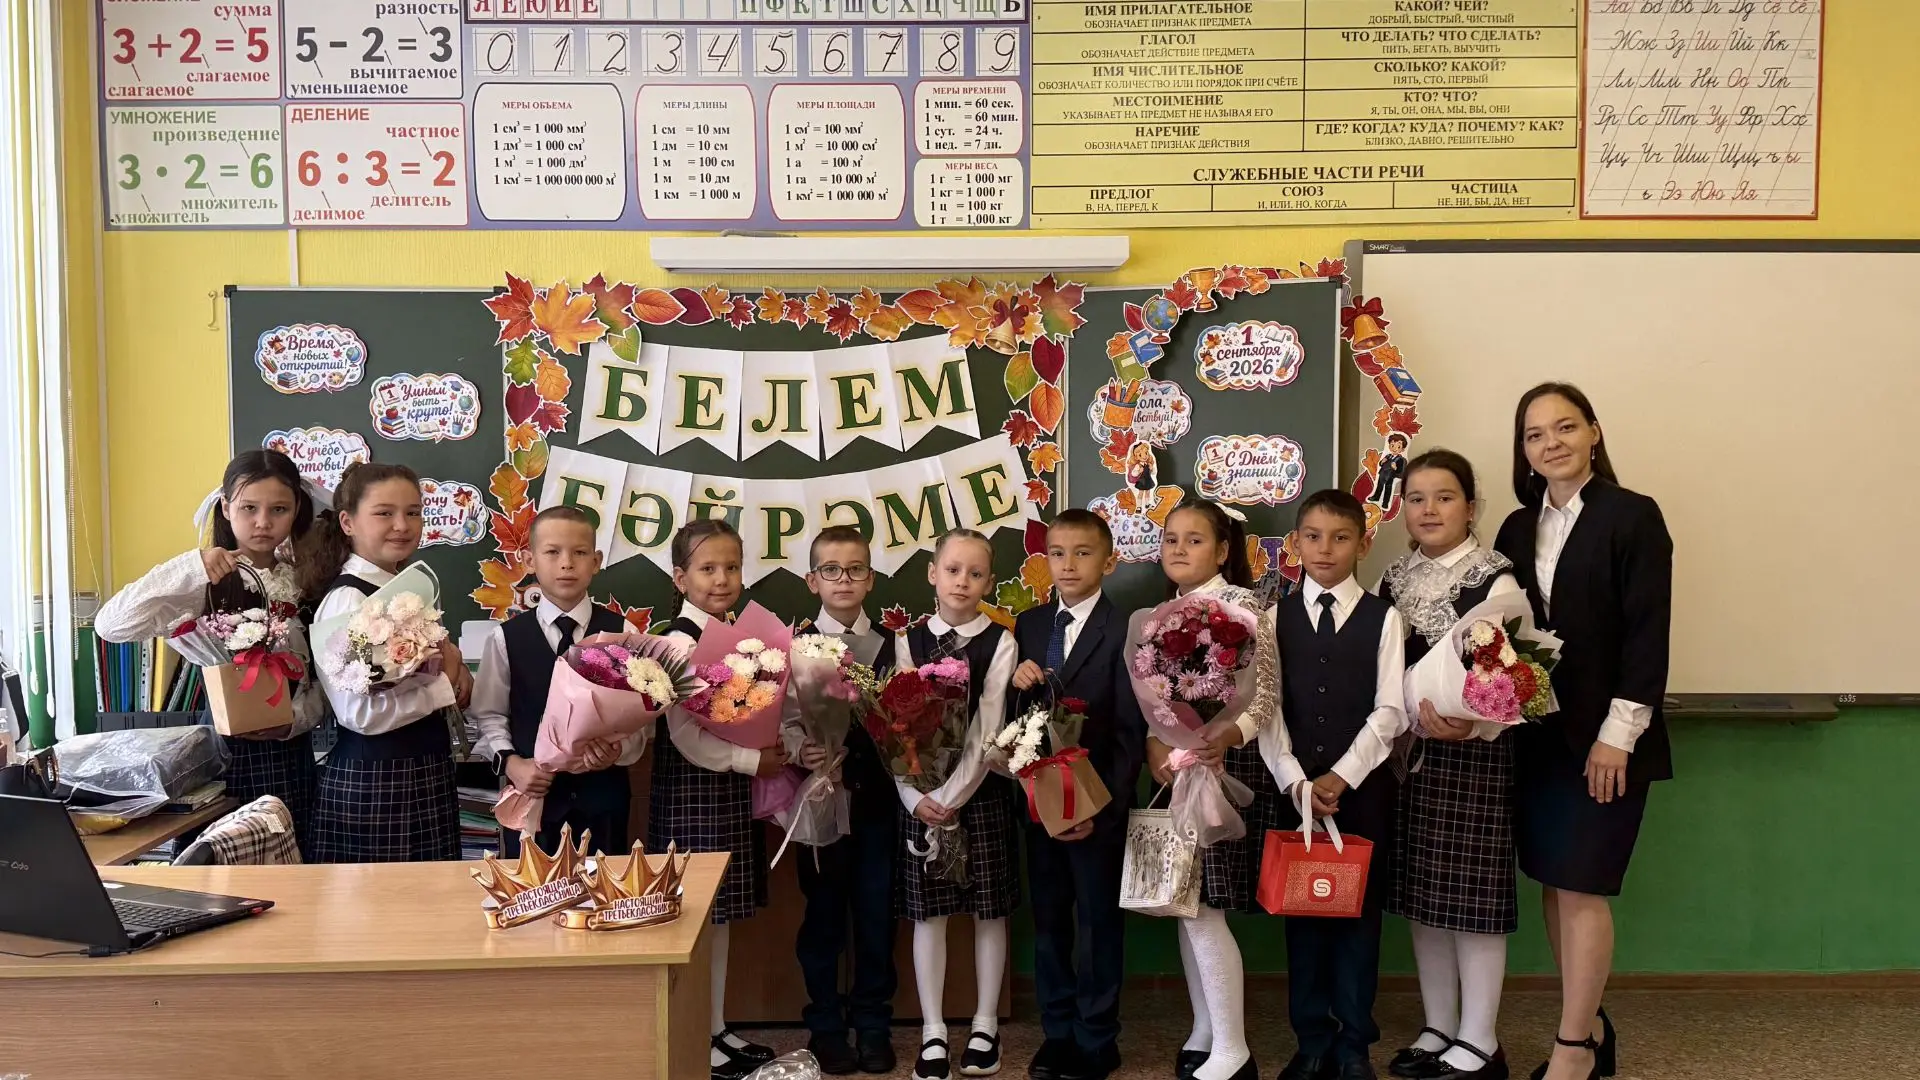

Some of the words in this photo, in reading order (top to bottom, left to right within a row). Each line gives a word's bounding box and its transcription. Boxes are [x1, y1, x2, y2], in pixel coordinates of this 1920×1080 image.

[213, 4, 272, 19] сумма
[375, 3, 459, 17] разность
[1085, 5, 1116, 16] ИМЯ
[1120, 2, 1253, 15] ПРИЛАГАТЕЛЬНОЕ
[1395, 0, 1450, 11] КАКОЙ?
[1454, 0, 1489, 11] ЧЕЙ?
[1084, 19, 1149, 28] ОБОЗНАЧАЕТ
[1151, 18, 1197, 27] ПРИЗНАК
[1199, 17, 1252, 27] ПРЕДМЕТА
[1368, 14, 1411, 25] ДОБРЫЙ,
[1414, 13, 1464, 24] БЫСТРЫЙ,
[1140, 34, 1196, 45] ГЛАГОЛ
[1342, 31, 1369, 42] ЧТО
[1372, 30, 1434, 43] ДЕЛАТЬ?
[1439, 30, 1467, 41] ЧТО
[1470, 30, 1541, 42] СДЕЛАТЬ?
[113, 28, 136, 65] 3
[180, 28, 202, 64] 2
[247, 27, 269, 63] 5
[296, 27, 318, 63] 5
[362, 27, 385, 62] 2
[430, 26, 453, 63] 3
[1382, 45, 1410, 54] ПИТЬ,
[1413, 45, 1452, 54] БЕГАТЬ,
[1454, 44, 1500, 53] ВЫУЧИТЬ
[487, 33, 513, 71] 0
[554, 33, 570, 71] 1
[603, 33, 627, 72] 2
[656, 33, 682, 72] 3
[708, 33, 738, 72] 4
[764, 34, 793, 72] 5
[824, 33, 849, 72] 6
[878, 34, 903, 72] 7
[938, 33, 960, 71] 8
[990, 33, 1016, 71] 9
[1081, 49, 1146, 58] ОБОЗНАЧАЕТ
[1148, 48, 1200, 58] ДЕЙСТВИЕ
[1202, 47, 1255, 57] ПРЕДМЕТА
[350, 66, 457, 80] вычитаемое
[1093, 66, 1124, 77] ИМЯ
[1129, 64, 1243, 76] ЧИСЛИТЕЛЬНОЕ
[1374, 61, 1447, 73] СКОЛЬКО?
[1451, 59, 1506, 71] КАКОЙ?
[186, 70, 270, 83] слагаемое
[1038, 81, 1102, 90] ОБОЗНАЧАЕТ
[1105, 80, 1170, 89] КОЛИЧЕСТВО
[1173, 80, 1193, 88] ИЛИ
[1196, 79, 1243, 88] ПОРЯДОК
[1245, 78, 1264, 86] ПРИ
[1266, 76, 1298, 86] СЧЁТЕ
[1393, 76, 1421, 85] ПЯТЬ,
[1423, 76, 1445, 84] СТО,
[1448, 74, 1488, 84] ПЕРВЫЙ
[1727, 67, 1749, 88] Оо
[109, 84, 194, 97] слагаемое
[290, 83, 408, 98] уменьшаемое
[932, 87, 960, 95] МЕРЫ
[962, 87, 1006, 95] ВРЕМЕНИ
[1404, 91, 1438, 102] КТО?
[1443, 91, 1478, 101] ЧТО?
[502, 101, 531, 110] МЕРЫ
[532, 101, 572, 110] ОБЪЕМА
[663, 101, 690, 109] МЕРЫ
[692, 101, 727, 110] ДЛИНЫ
[797, 101, 825, 109] МЕРЫ
[826, 101, 876, 110] ПЛОЩАДИ
[1113, 95, 1223, 107] МЕСТОИМЕНИЕ
[110, 110, 217, 125] УМНОЖЕНИЕ
[291, 109, 370, 124] ДЕЛЕНИЕ
[1063, 111, 1122, 120] УКАЗЫВАЕТ
[1124, 111, 1138, 119] НА
[1140, 110, 1187, 119] ПРЕДМЕТ
[1189, 109, 1202, 118] НЕ
[1204, 109, 1252, 117] НАЗЫВАЯ
[1254, 108, 1274, 117] ЕГО
[386, 125, 460, 139] частное
[1135, 126, 1200, 137] НАРЕЧИЕ
[1316, 123, 1348, 135] ГДЕ?
[1352, 123, 1406, 134] КОГДА?
[1409, 122, 1454, 134] КУДА?
[1458, 121, 1525, 132] ПОЧЕМУ?
[1529, 121, 1564, 131] КАК?
[152, 129, 280, 143] произведение
[1365, 137, 1406, 146] БЛИЗКО,
[1408, 136, 1445, 145] ДАВНО,
[1447, 135, 1515, 144] РЕШИТЕЛЬНО
[1084, 141, 1148, 150] ОБОЗНАЧАЕТ
[1151, 140, 1196, 149] ПРИЗНАК
[1198, 138, 1250, 149] ДЕЙСТВИЯ
[118, 154, 141, 190] 3
[184, 154, 207, 189] 2
[250, 152, 273, 189] 6
[298, 150, 321, 187] 6
[365, 150, 388, 187] 3
[433, 150, 456, 187] 2
[945, 162, 973, 170] МЕРЫ
[975, 162, 998, 170] ВЕСА
[1193, 167, 1308, 181] СЛУЖЕБНЫЕ
[1314, 166, 1373, 179] ЧАСТИ
[1379, 165, 1424, 178] РЕЧИ
[1090, 188, 1154, 200] ПРЕДЛОГ
[1282, 186, 1323, 197] СОЮЗ
[1451, 183, 1518, 195] ЧАСТИЦА
[181, 198, 278, 210] множитель
[371, 195, 451, 208] делитель
[114, 211, 209, 224] множитель
[293, 208, 365, 221] делимое
[1241, 326, 1254, 345] 1
[286, 335, 335, 352] Время
[1216, 341, 1282, 360] сентября
[293, 350, 330, 360] новых
[280, 359, 347, 373] открытий!
[1230, 359, 1274, 376] 2026
[401, 384, 447, 400] Умным
[596, 359, 974, 432] БЕЛЕМ
[412, 398, 439, 407] быть
[1137, 398, 1166, 409] ола,
[407, 402, 453, 422] круто!
[290, 443, 305, 458] К
[308, 441, 340, 461] учёбе
[298, 455, 347, 472] отовы!
[1225, 451, 1236, 467] С
[1239, 451, 1278, 466] Днём
[1225, 463, 1284, 485] знаний!
[423, 496, 448, 508] очу
[423, 509, 464, 527] нать!
[1116, 529, 1163, 546] класс!
[516, 878, 569, 902] НАСТОЯЩАЯ
[507, 884, 581, 917] ТРЕТЬЕКЛАССНИЦА
[614, 893, 663, 910] НАСТОЯЩИЙ
[604, 903, 668, 920] ТРЕТЬЕКЛАССНИК
